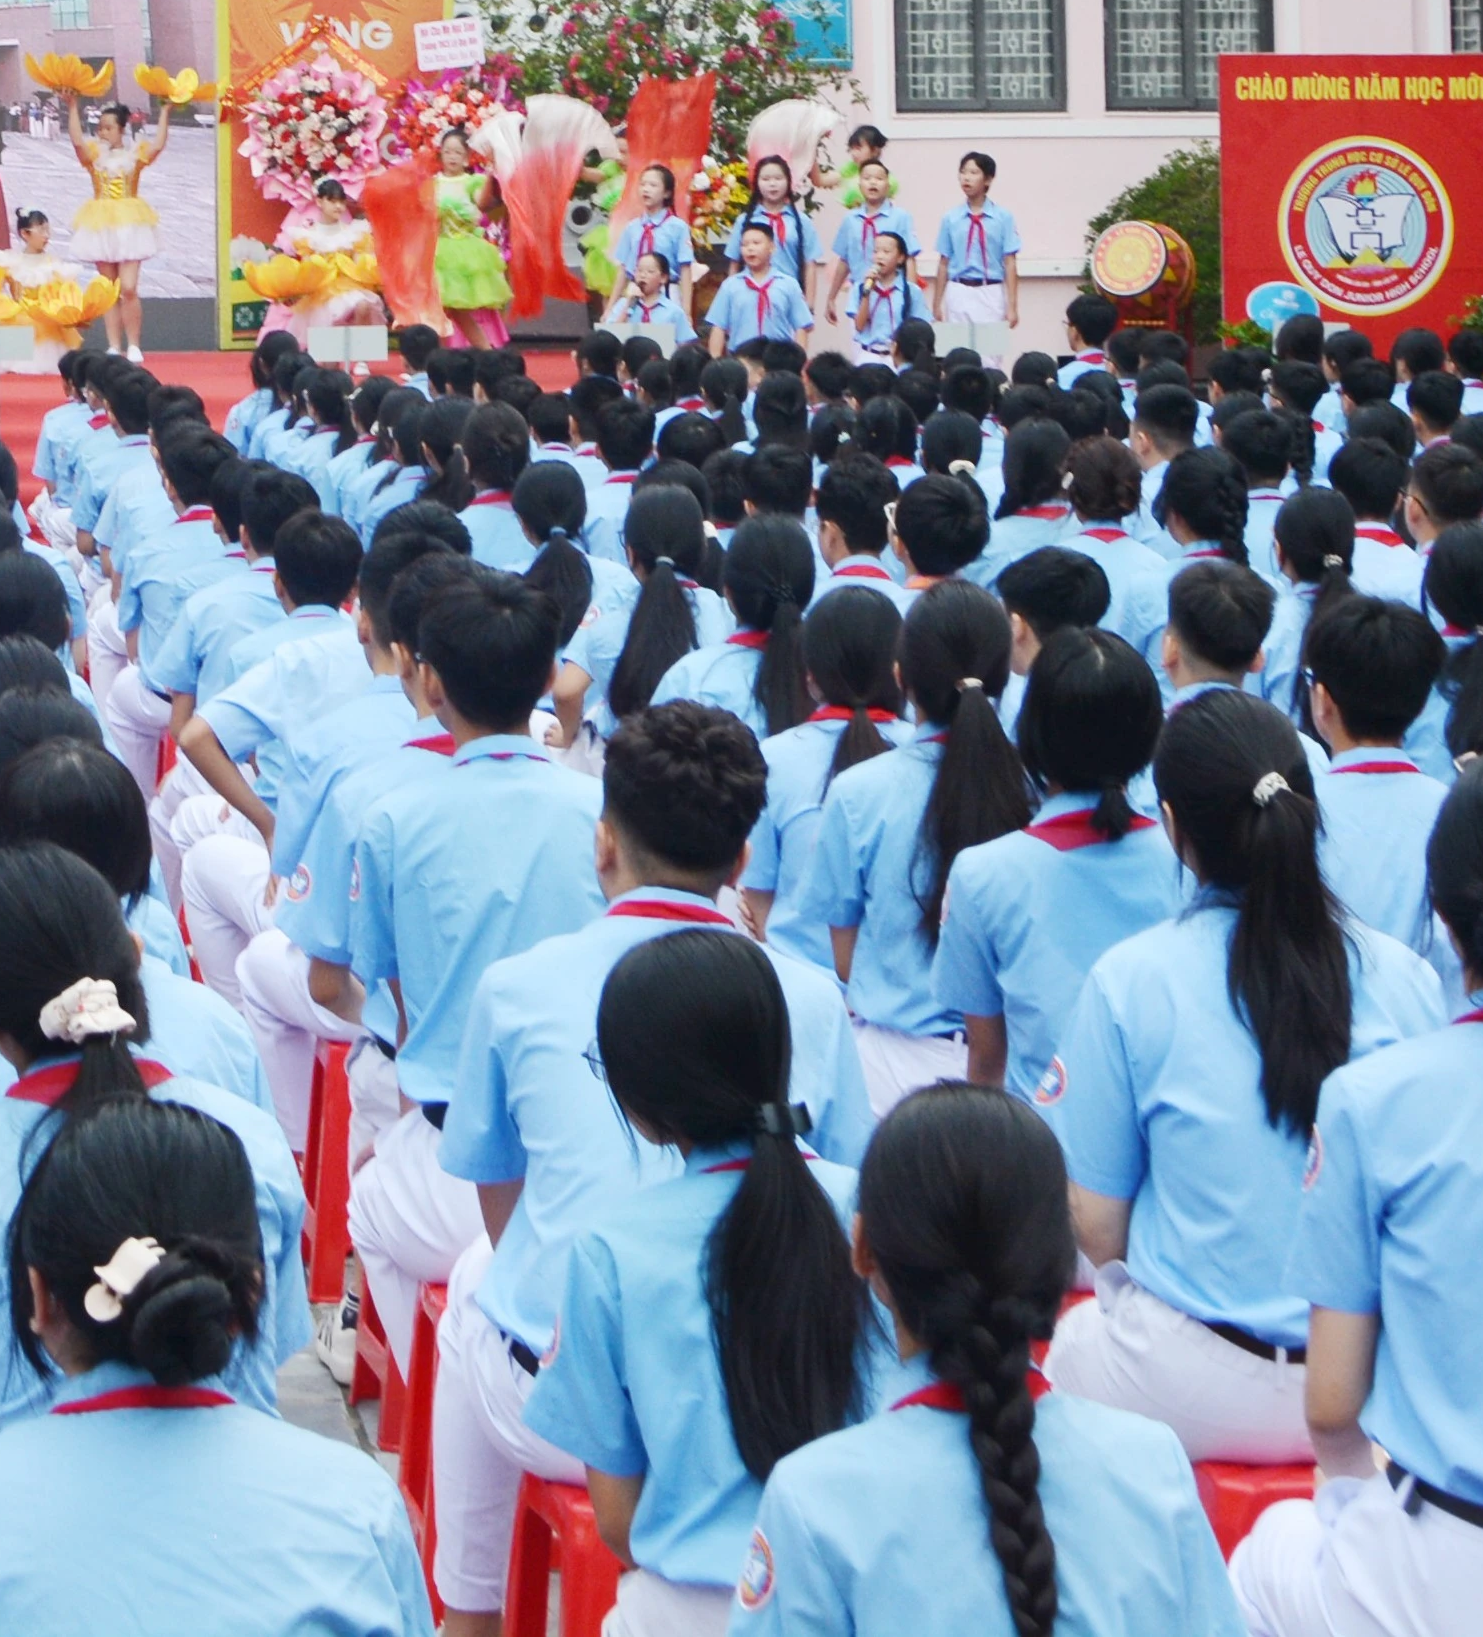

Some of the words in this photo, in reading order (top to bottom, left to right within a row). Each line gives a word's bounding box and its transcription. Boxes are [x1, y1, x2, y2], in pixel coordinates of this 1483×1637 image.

[279, 14, 393, 51] VNG
[1236, 72, 1287, 100] CHÀO
[1292, 72, 1350, 100] MỪNG
[1355, 72, 1400, 100] NĂM
[1405, 76, 1443, 105] HỌC
